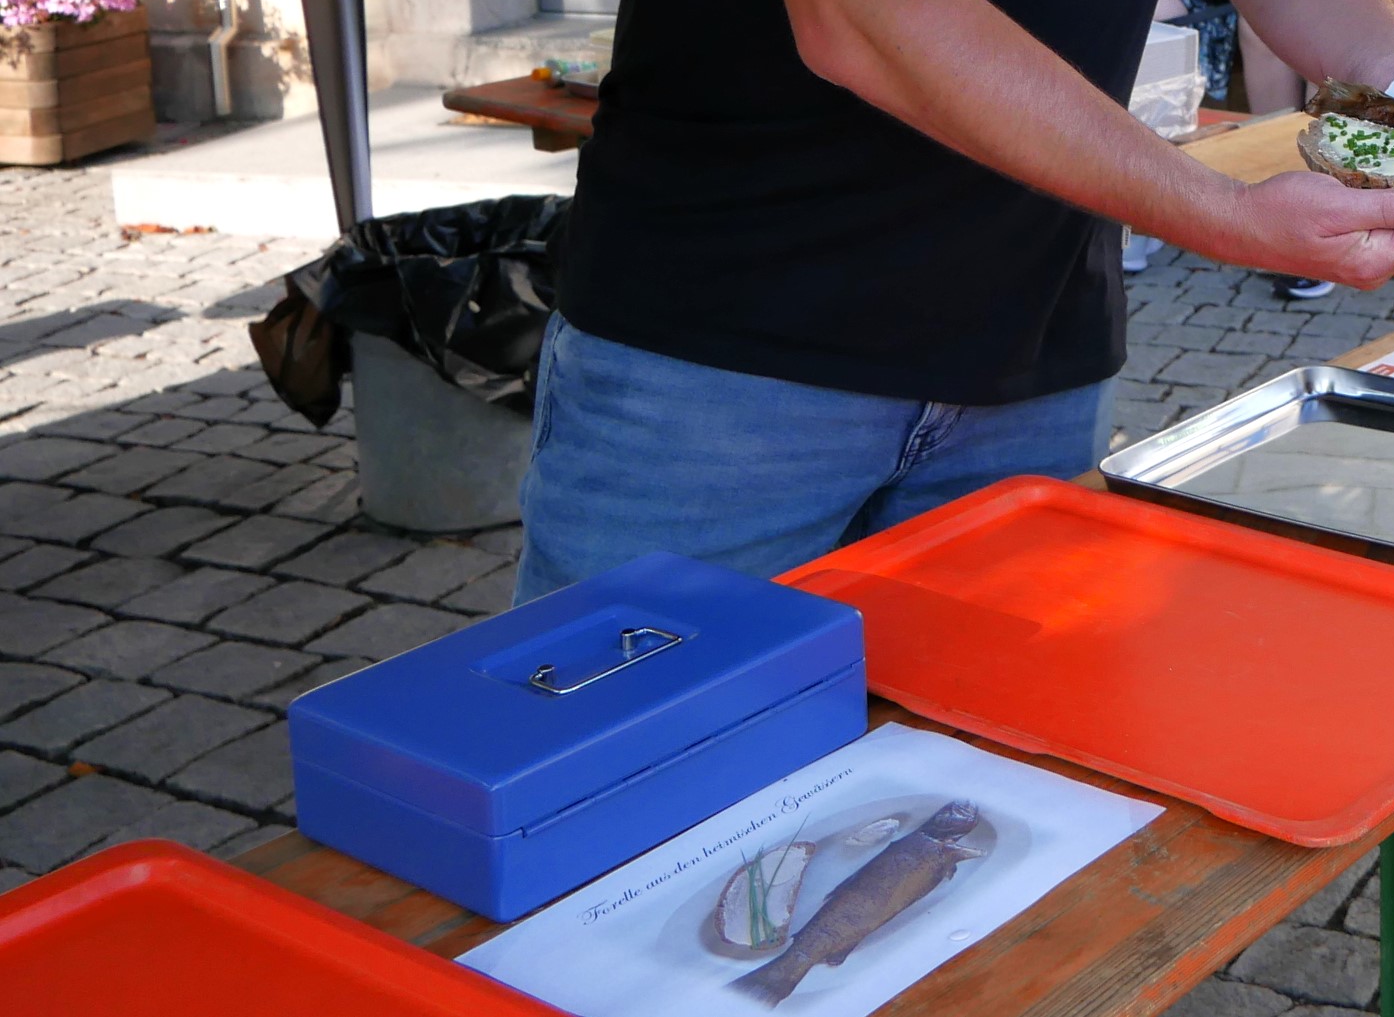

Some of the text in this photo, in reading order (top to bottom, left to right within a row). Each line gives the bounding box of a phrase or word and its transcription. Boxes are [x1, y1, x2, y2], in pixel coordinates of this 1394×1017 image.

[577, 767, 853, 926] Forelle aus den heimischen Gewässern
